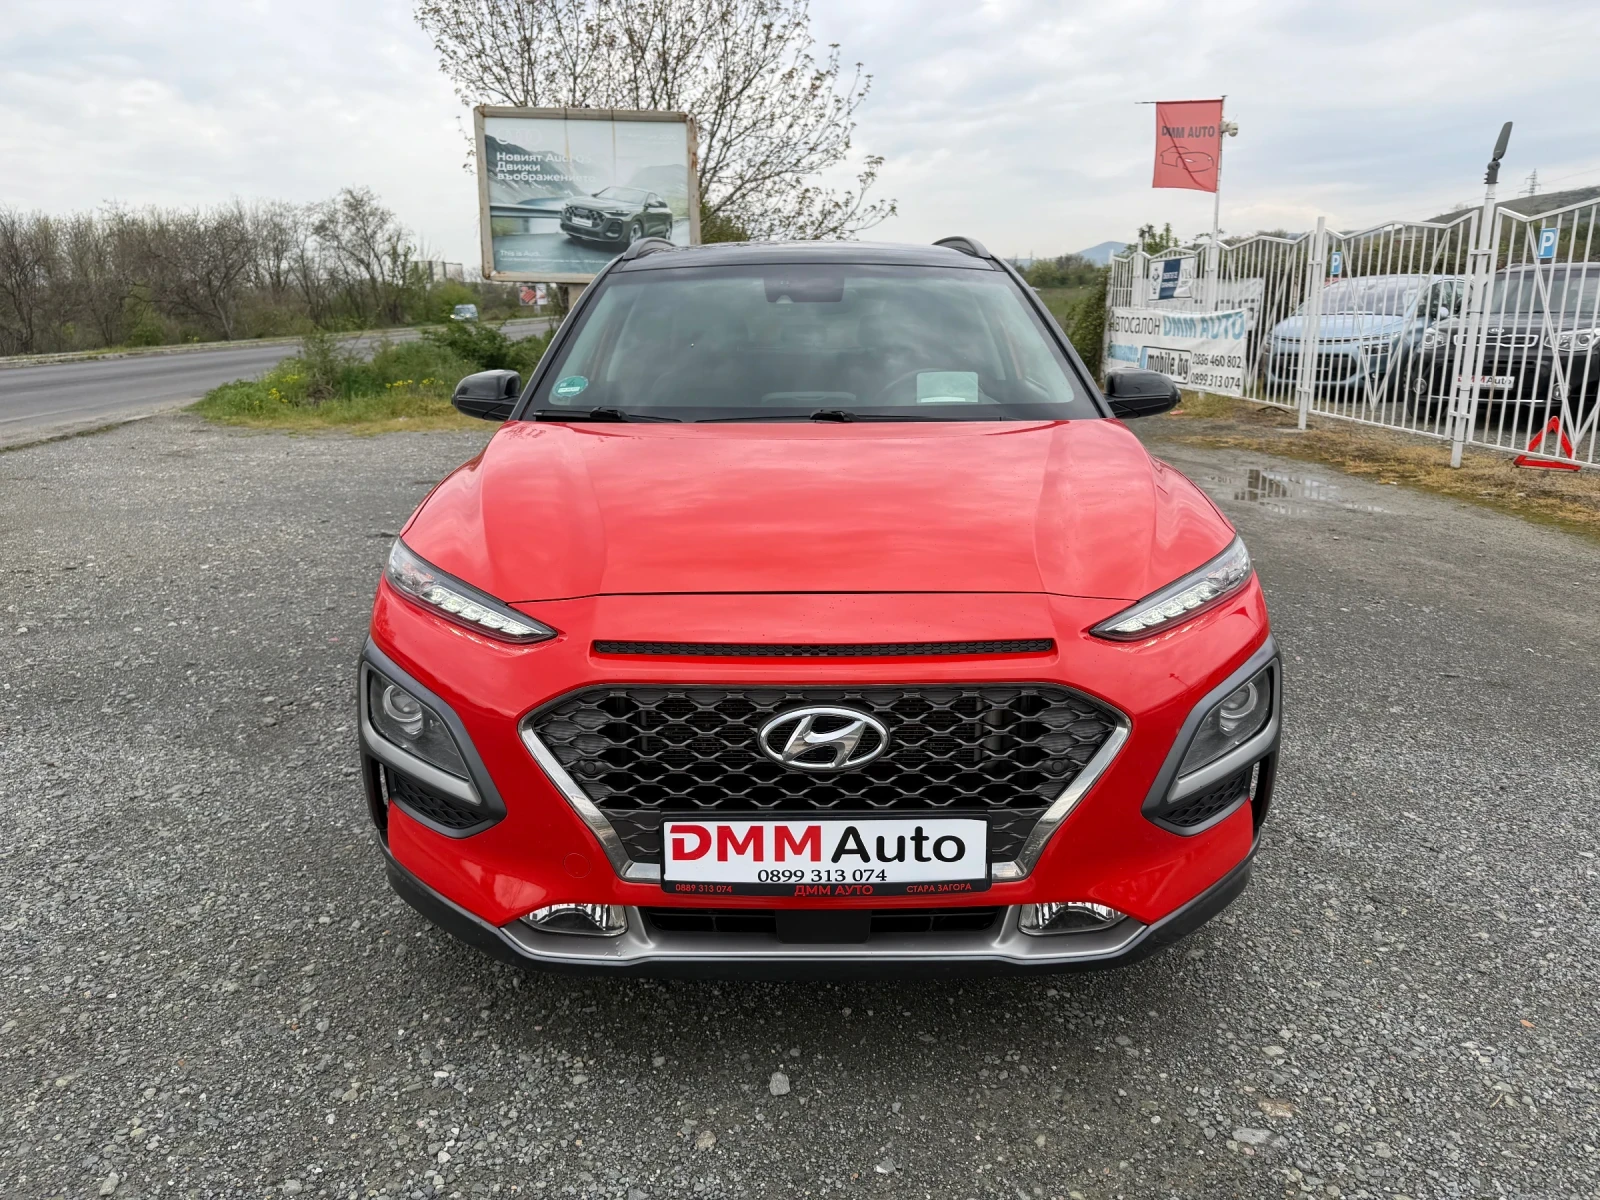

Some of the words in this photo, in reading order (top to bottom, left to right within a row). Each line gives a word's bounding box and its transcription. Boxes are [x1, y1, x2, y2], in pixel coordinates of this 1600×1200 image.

[1161, 126, 1185, 138] DMM
[1187, 126, 1216, 138] AUTO
[496, 151, 542, 162] Новият
[496, 161, 541, 172] Движи
[1540, 231, 1555, 256] P
[1331, 254, 1340, 272] P
[1108, 312, 1160, 335] Автосалон
[1163, 315, 1196, 338] DMM
[1200, 311, 1245, 340] AUTO
[1210, 354, 1226, 367] 460
[1227, 355, 1242, 369] 802
[1190, 372, 1208, 385] 0899
[1208, 374, 1223, 388] 313
[1224, 376, 1241, 390] 074
[670, 825, 822, 863] DMM
[831, 826, 967, 863] Auto
[757, 868, 806, 883] 0899
[811, 869, 847, 883] 313
[852, 868, 888, 882] 074
[675, 883, 696, 892] 0889
[698, 884, 714, 893] 313
[716, 885, 732, 894] 074
[794, 884, 831, 897] ДММ
[834, 884, 874, 895] АУТО
[906, 884, 936, 893] СТАРА
[937, 882, 972, 892] ЗАГОРА
